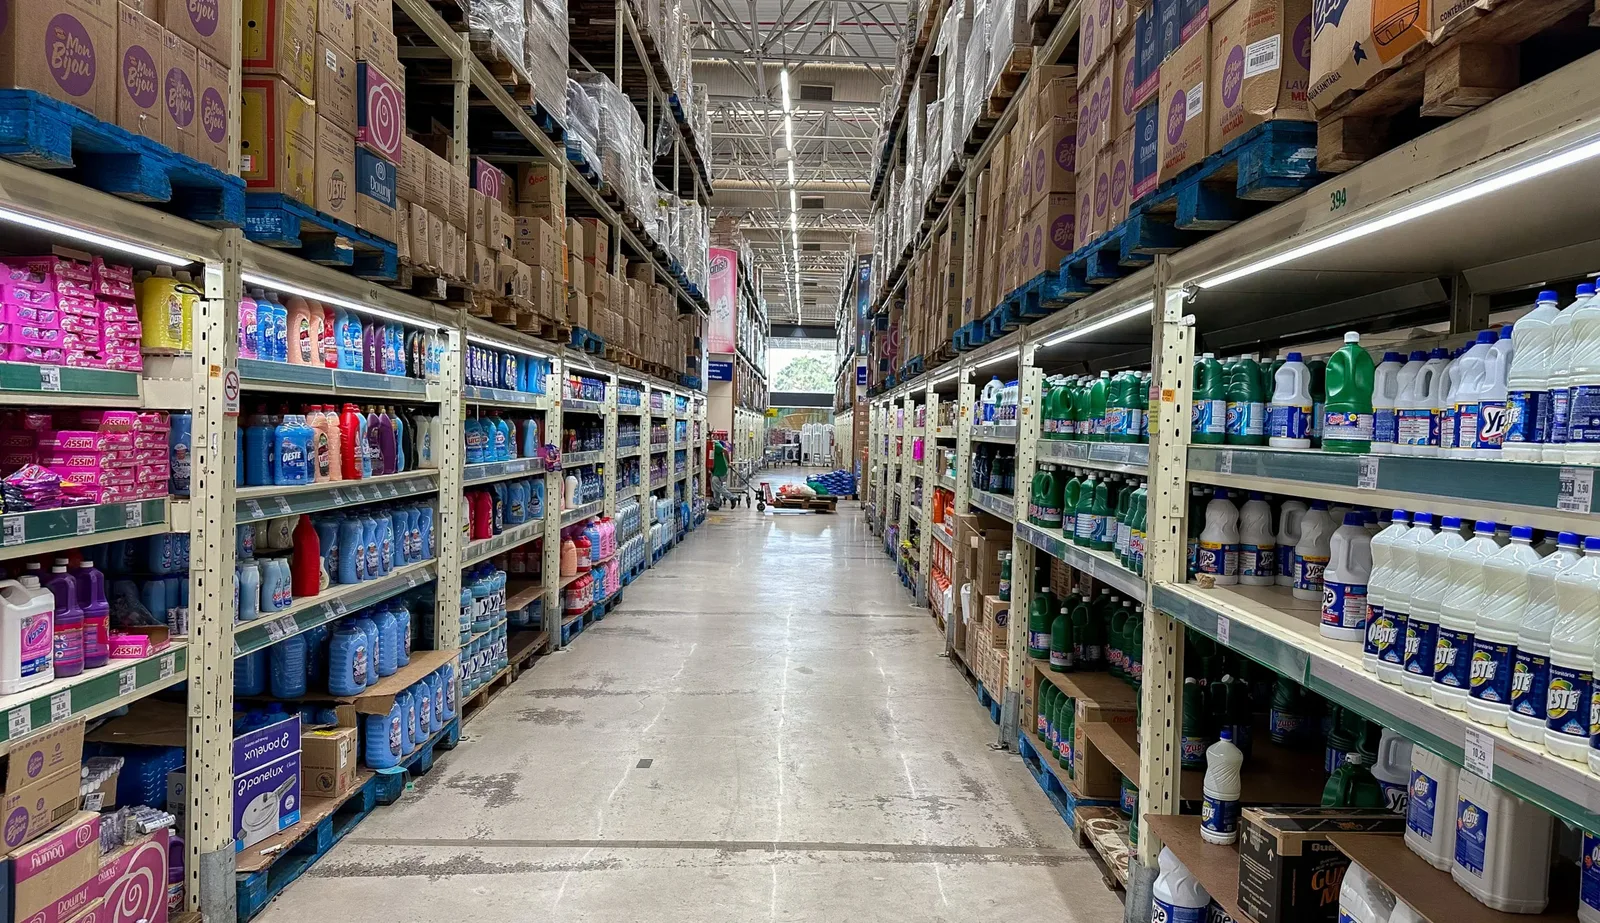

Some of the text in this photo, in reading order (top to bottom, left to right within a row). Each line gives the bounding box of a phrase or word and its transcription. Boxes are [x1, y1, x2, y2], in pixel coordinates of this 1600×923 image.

[66, 32, 92, 58] Mon
[51, 41, 91, 80] Bijou
[137, 60, 155, 79] Mon
[127, 66, 155, 97] Bijou
[176, 83, 192, 98] Mon
[1286, 80, 1309, 90] LAV
[168, 88, 191, 116] Bijou
[204, 106, 224, 132] Bijou
[327, 178, 346, 200] OESTE
[370, 175, 391, 203] Downy
[1330, 188, 1347, 211] 394
[709, 257, 728, 275] anish
[369, 289, 378, 300] 424
[63, 439, 93, 449] ASSIM
[66, 457, 96, 467] ASSIM
[282, 451, 301, 462] OESTE
[68, 474, 95, 483] ASSIM
[1577, 483, 1589, 494] 3,90
[112, 647, 142, 656] ASSIM
[244, 737, 280, 761] panelux
[1472, 747, 1486, 761] 10,29
[247, 765, 284, 791] panelux
[1414, 778, 1430, 794] OESTE
[1462, 808, 1479, 825] OESTE
[30, 843, 65, 872] Downy
[98, 866, 116, 884] owny
[57, 888, 89, 915] Downy
